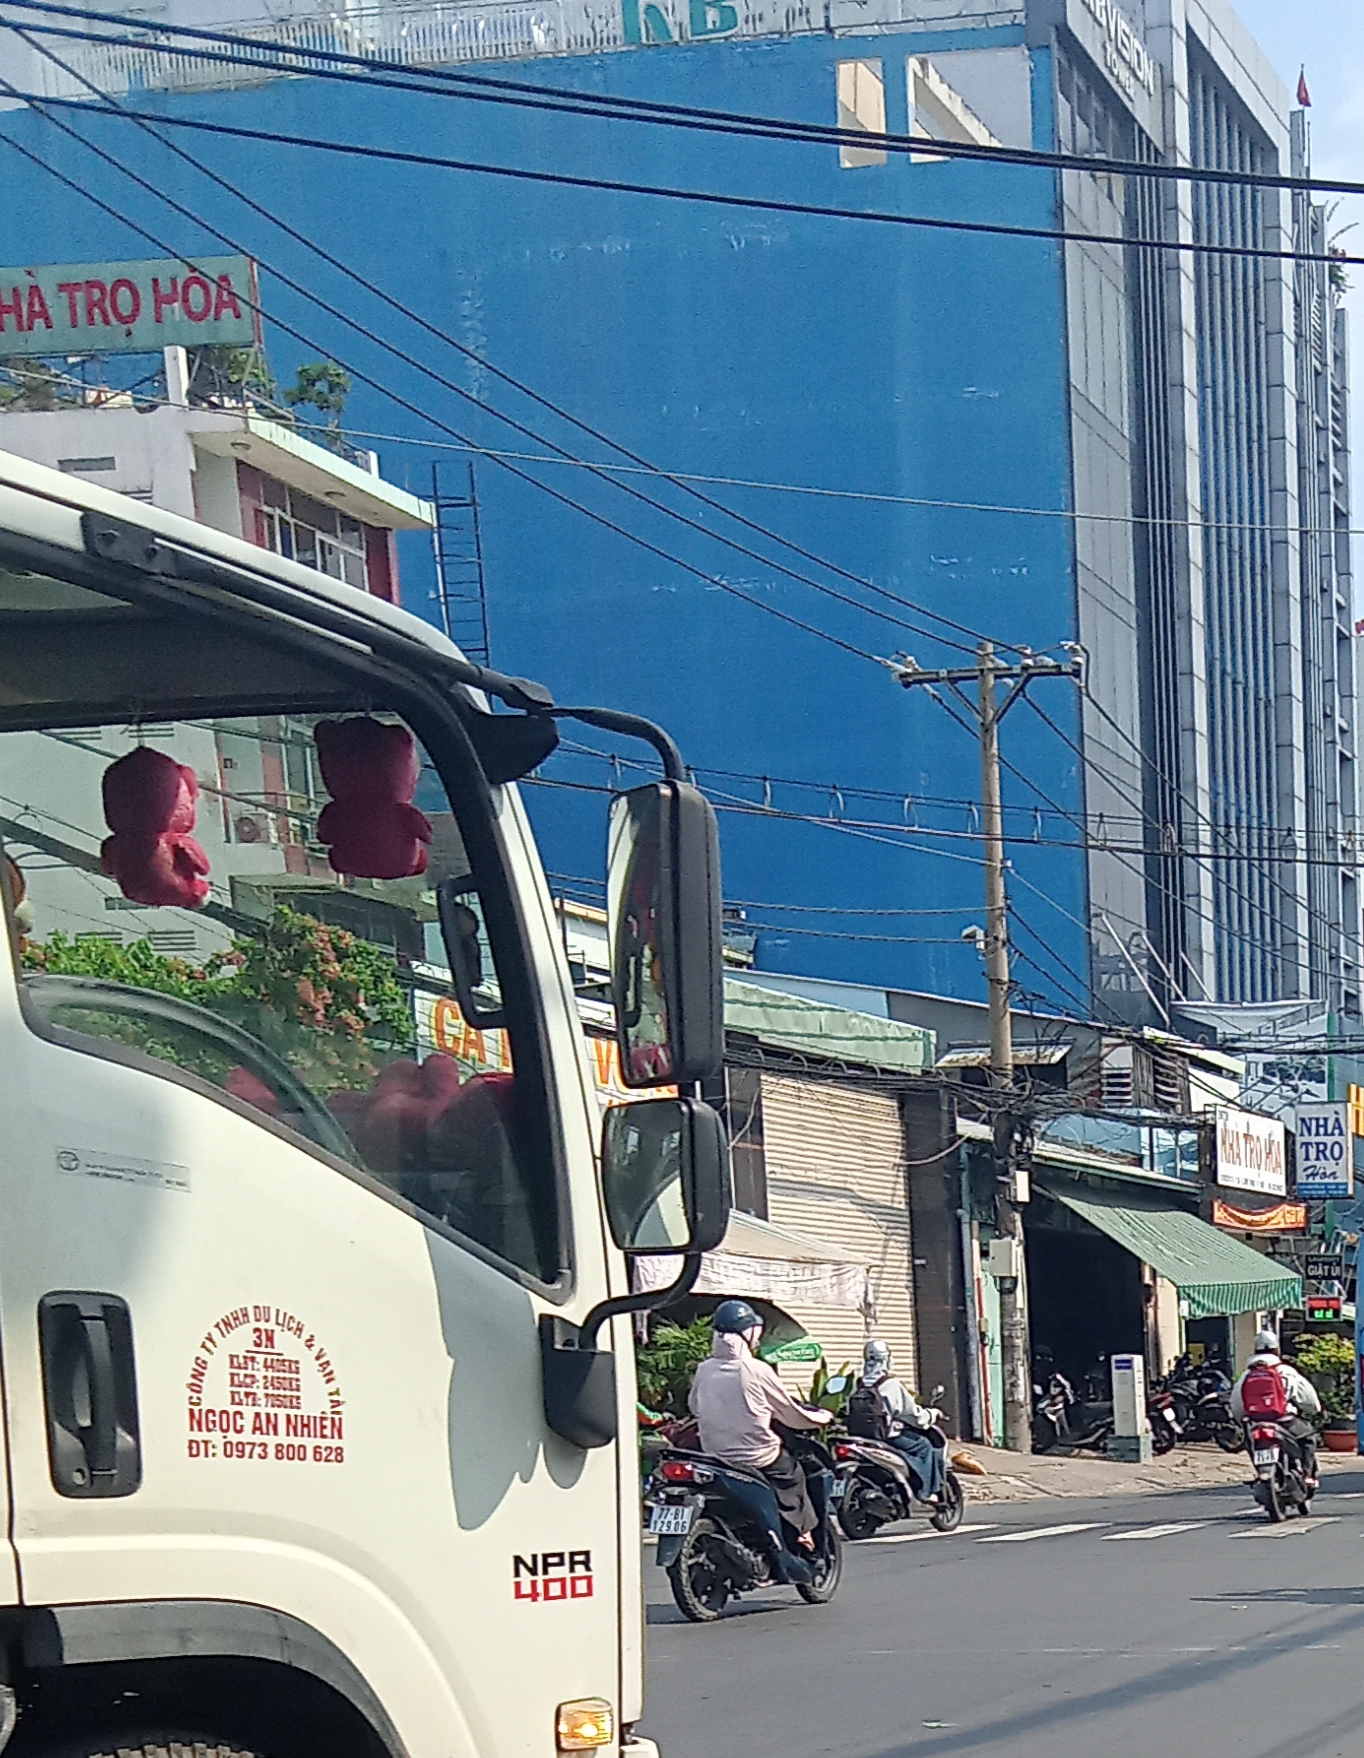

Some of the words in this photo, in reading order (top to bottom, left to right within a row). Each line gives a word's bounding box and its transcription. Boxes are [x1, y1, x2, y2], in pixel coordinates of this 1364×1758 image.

[57, 278, 141, 337] TRỌ
[1299, 1110, 1345, 1137] NHÀ
[1300, 1141, 1344, 1166] TRỌ
[253, 1327, 275, 1349] 3N
[186, 1356, 208, 1407] CÔNG
[200, 1332, 217, 1355] TY
[214, 1306, 251, 1338] TNHH
[253, 1305, 271, 1323] DU
[275, 1308, 305, 1339] LỊCH
[304, 1334, 315, 1351] &
[188, 1408, 244, 1439] NGỌC
[252, 1411, 279, 1436] AN
[285, 1411, 343, 1440] NHIÊN
[187, 1439, 217, 1458] ĐT:
[223, 1441, 268, 1460] 0973
[274, 1443, 307, 1462] 800
[313, 1445, 344, 1464] 628
[513, 1550, 592, 1578] NPR
[514, 1575, 593, 1602] 400
